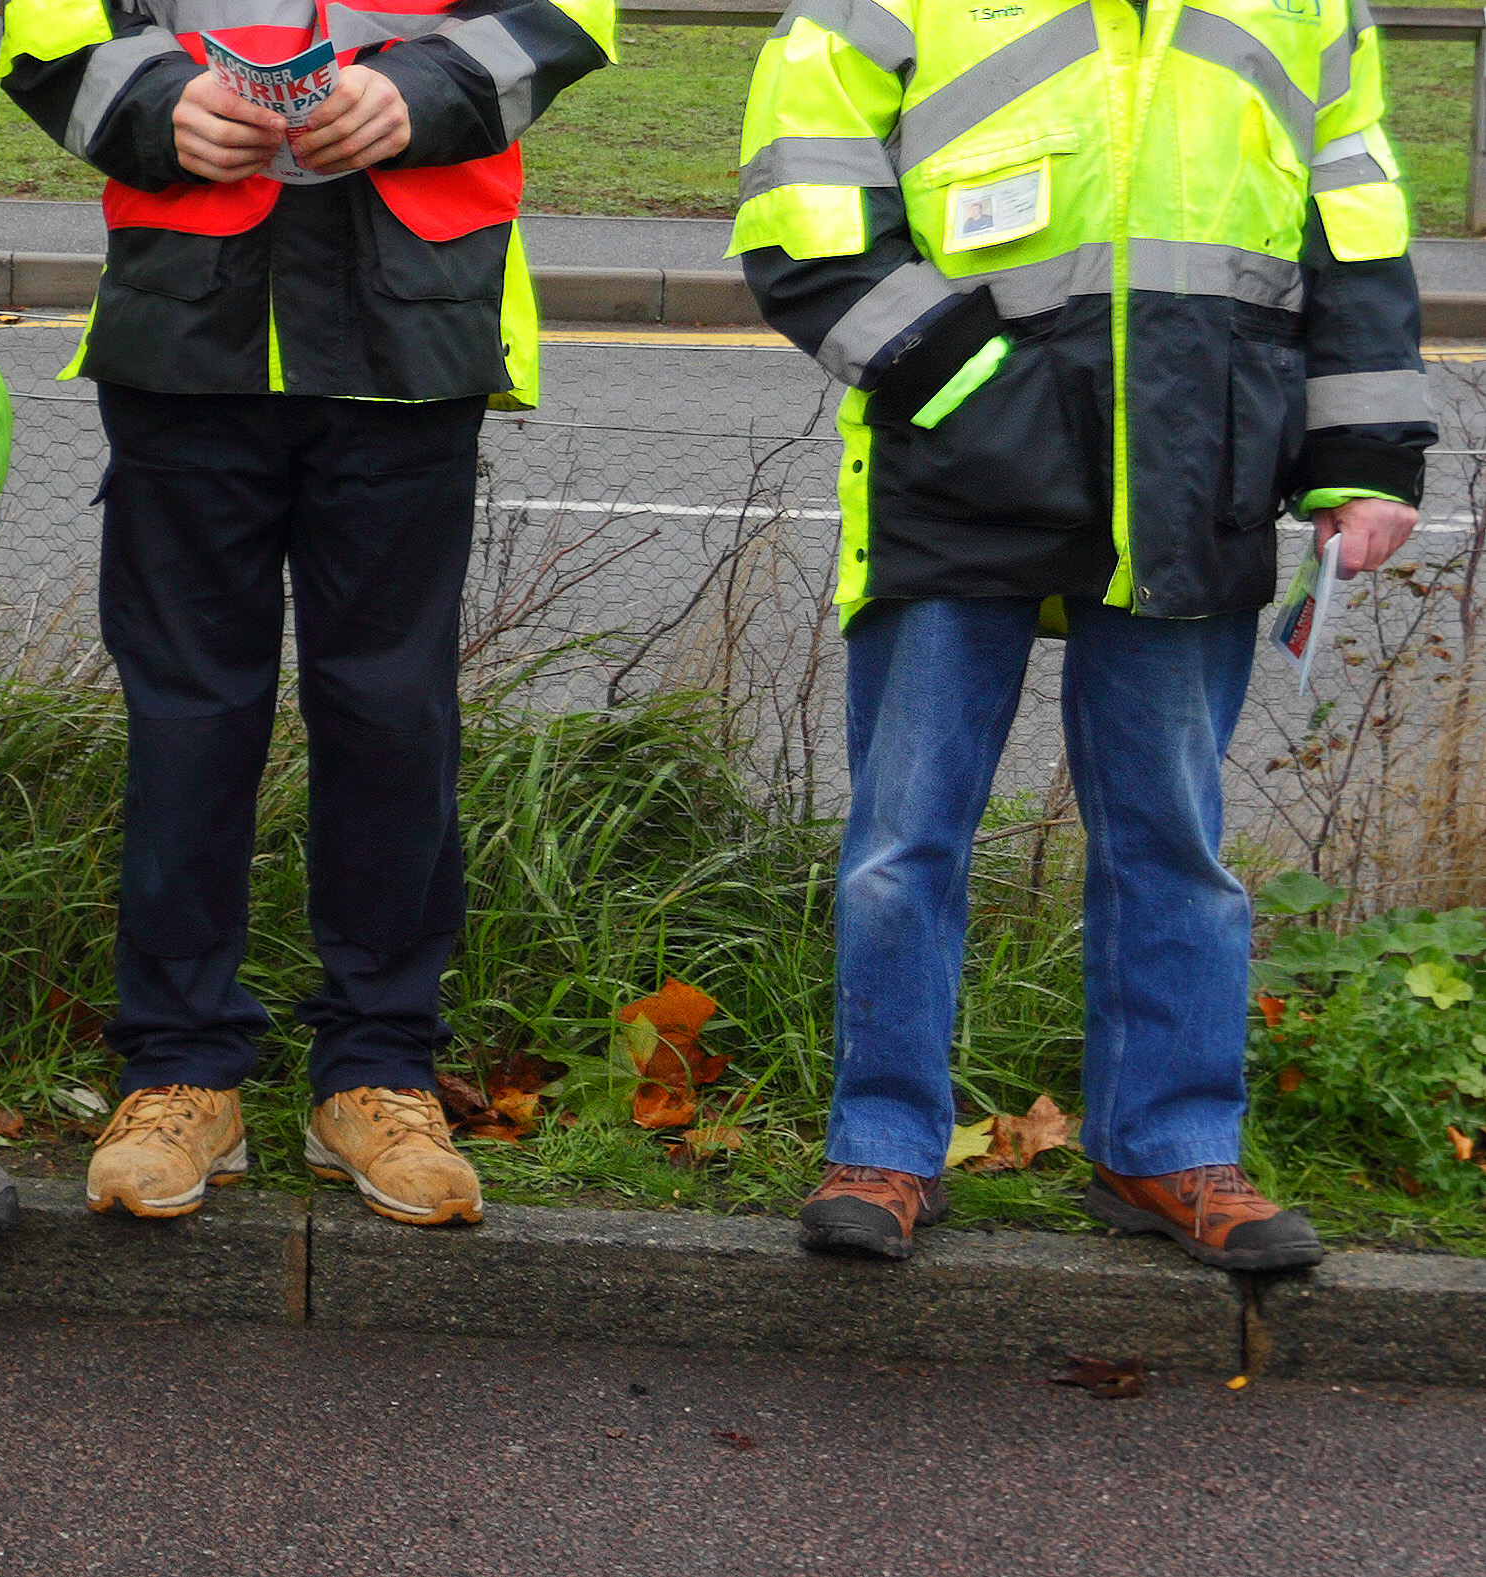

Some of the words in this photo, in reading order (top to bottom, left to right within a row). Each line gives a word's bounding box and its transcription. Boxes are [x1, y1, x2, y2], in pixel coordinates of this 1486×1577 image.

[214, 61, 332, 101] STRIKE
[225, 57, 294, 85] OCTOBER
[294, 83, 332, 111] PAY
